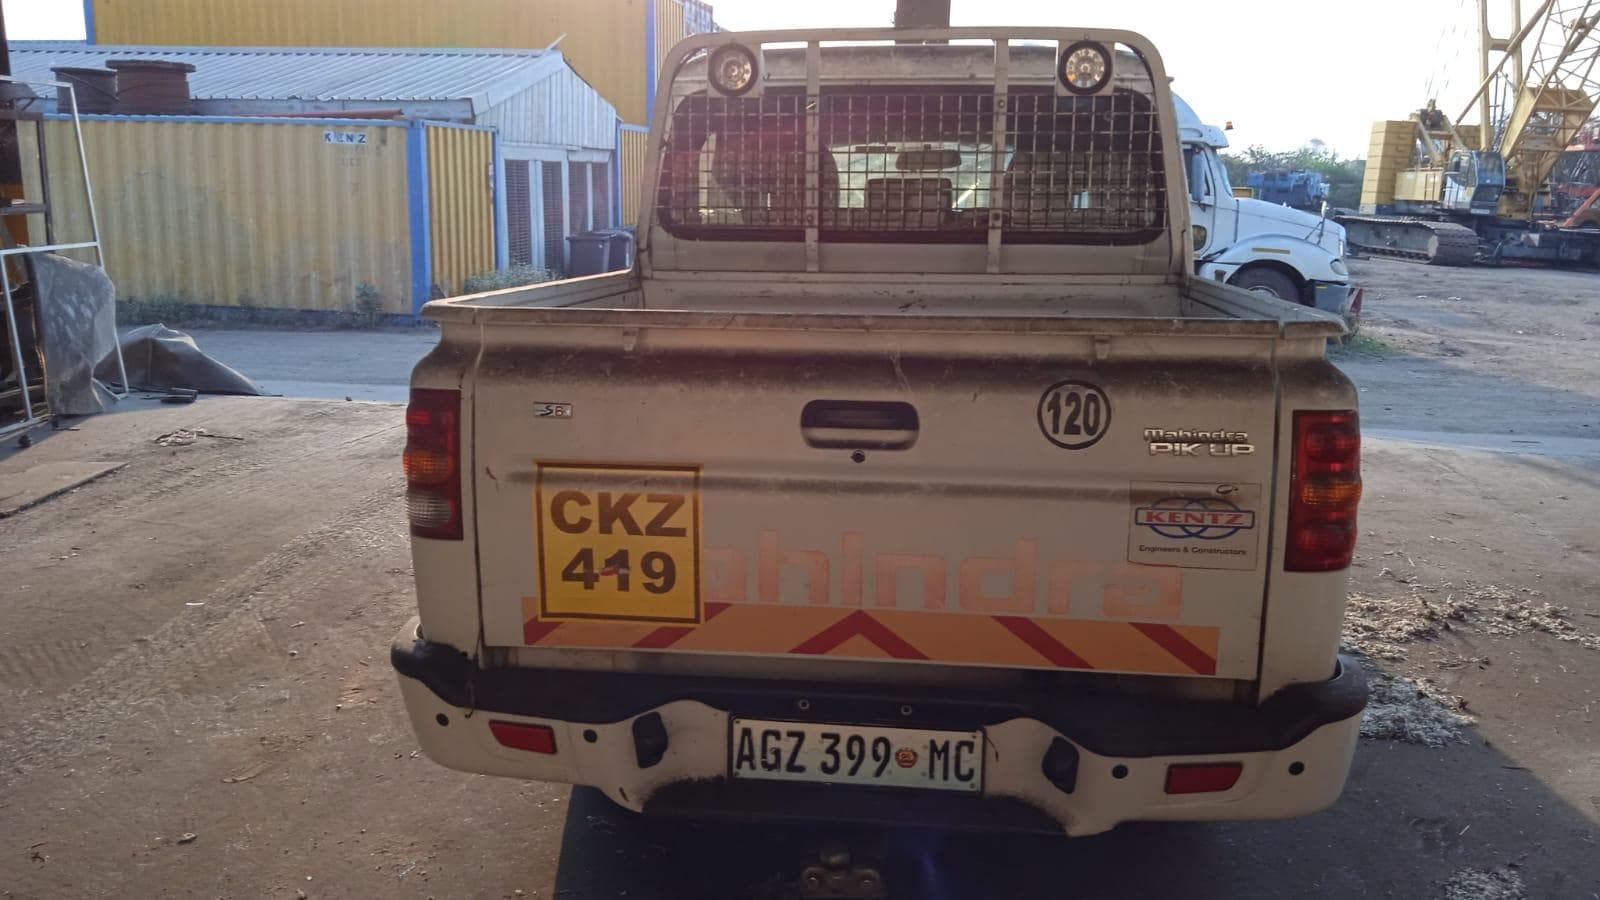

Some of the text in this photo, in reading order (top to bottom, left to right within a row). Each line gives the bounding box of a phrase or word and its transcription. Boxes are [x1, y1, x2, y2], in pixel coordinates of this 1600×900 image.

[324, 132, 367, 143] KENZ
[1046, 391, 1101, 436] 120
[1149, 442, 1255, 457] PIK UP
[550, 490, 687, 538] CKZ
[1145, 511, 1244, 525] KENTZ
[561, 547, 677, 595] 419
[1139, 544, 1181, 553] Engineers
[1191, 546, 1247, 555] Constructors
[704, 529, 1183, 620] ahindra
[735, 726, 976, 782] AGZ 399 MC
